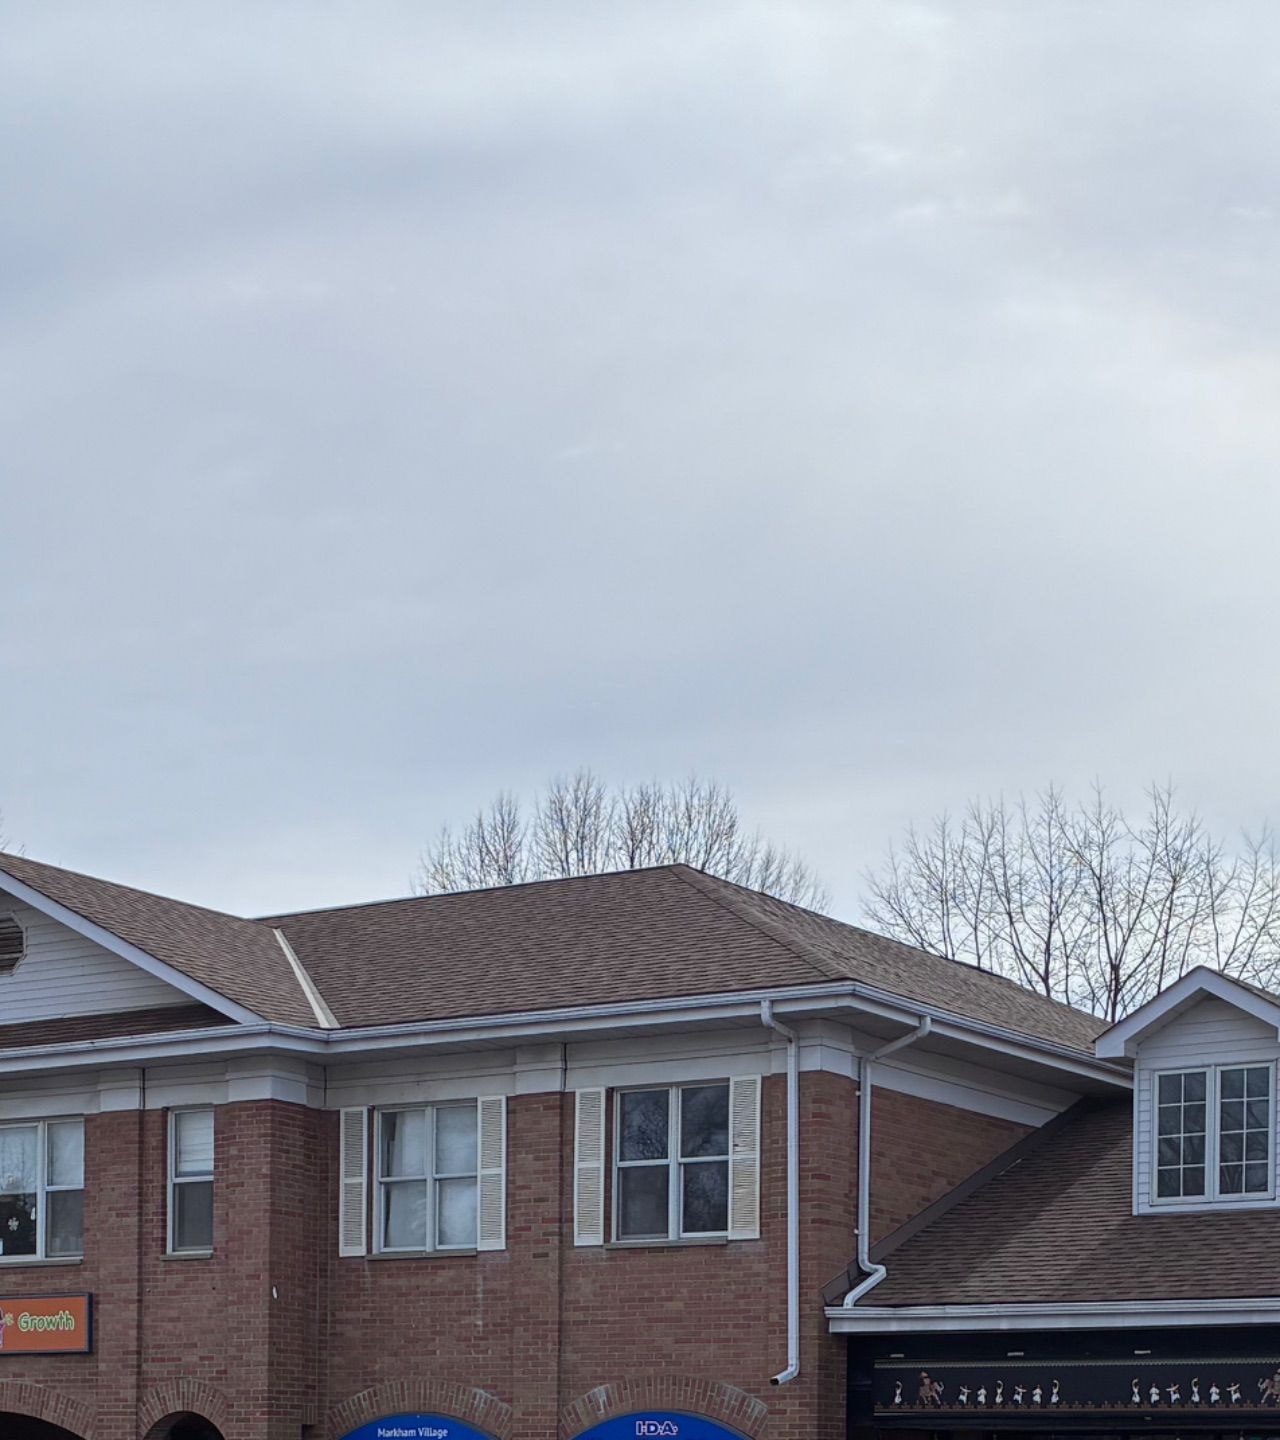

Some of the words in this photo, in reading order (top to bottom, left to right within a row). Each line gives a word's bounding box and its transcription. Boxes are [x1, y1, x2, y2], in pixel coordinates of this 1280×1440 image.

[18, 1310, 75, 1332] Growth
[377, 1427, 417, 1438] Markham
[418, 1427, 449, 1440] Village
